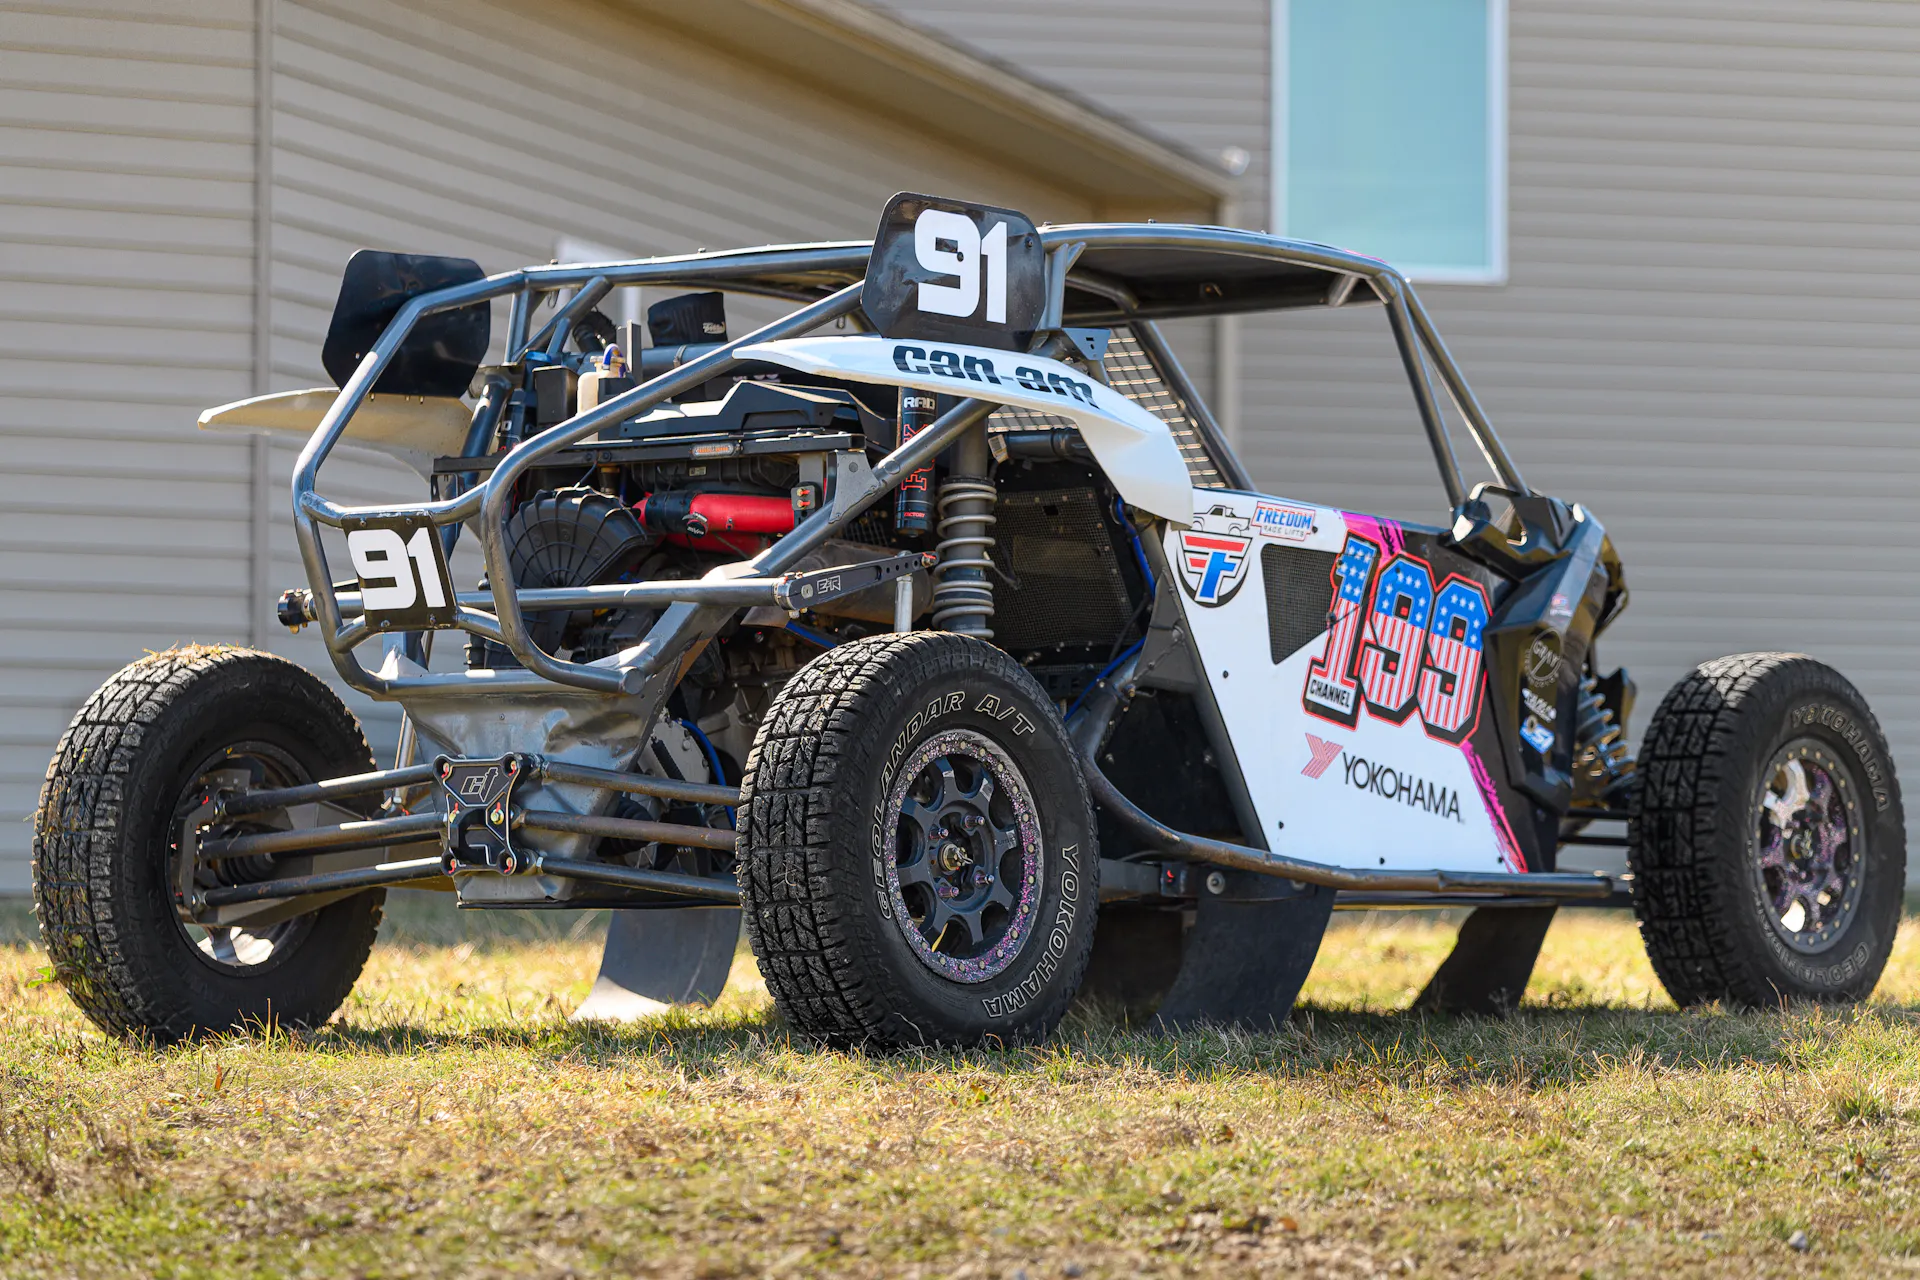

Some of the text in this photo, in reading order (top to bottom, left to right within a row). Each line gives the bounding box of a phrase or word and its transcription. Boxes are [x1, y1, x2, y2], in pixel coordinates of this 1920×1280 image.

[914, 208, 1007, 324] 91
[903, 396, 935, 410] RAD
[1255, 505, 1313, 530] FREEDOM
[347, 526, 447, 611] 91
[1306, 532, 1492, 740] 199
[1308, 679, 1351, 709] CHANNEL
[872, 690, 1036, 919] GEOLANDAR A/T
[1342, 751, 1461, 823] YOKOHAMA
[1790, 702, 1890, 812] YOKOHAMA
[982, 843, 1080, 1018] YOKOHAMA
